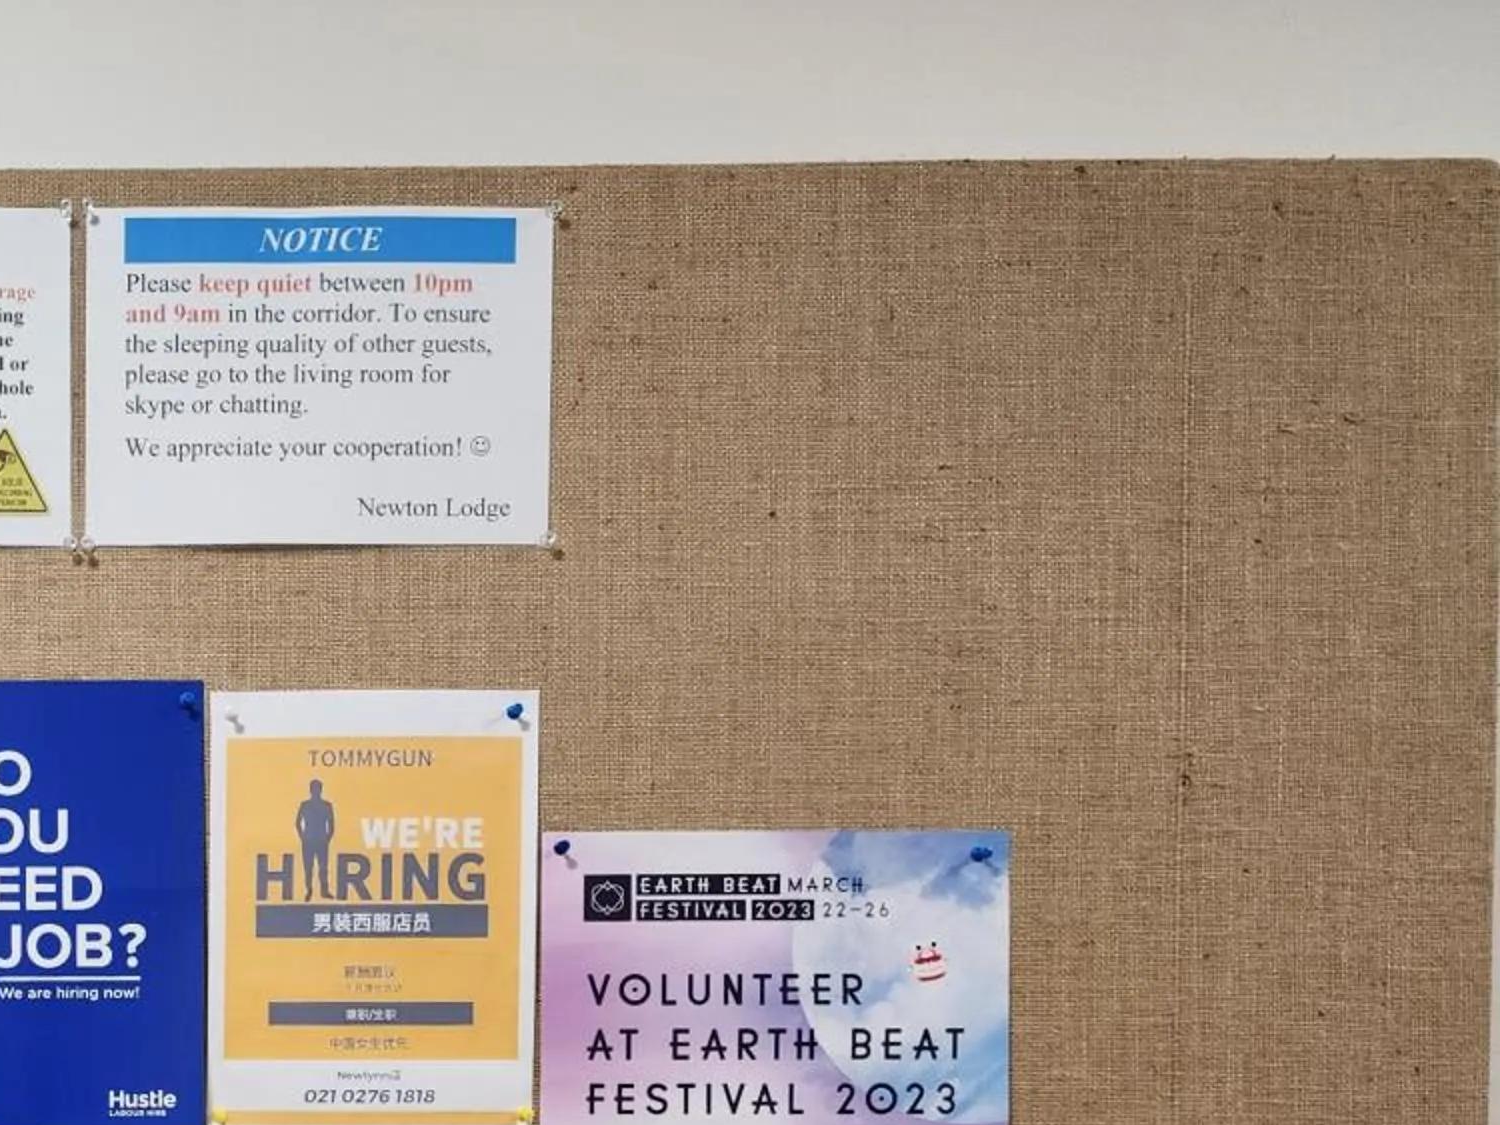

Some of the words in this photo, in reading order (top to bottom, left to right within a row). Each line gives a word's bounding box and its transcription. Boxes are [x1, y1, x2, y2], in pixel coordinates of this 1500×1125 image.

[260, 226, 383, 253] NOTICE
[126, 273, 192, 293] Please
[199, 274, 249, 297] keep
[257, 275, 311, 297] quiet
[319, 273, 405, 293] between
[413, 273, 472, 296] 10pm
[358, 498, 438, 517] Newton
[446, 497, 510, 520] Lodge
[308, 751, 433, 767] TOMMYGUN
[361, 817, 485, 850] WE'RE
[639, 877, 710, 894] EARTH
[723, 877, 778, 893] BEAT
[787, 877, 864, 893] MARCH
[639, 903, 743, 919] FESTIVAL
[754, 903, 813, 918] 2023
[313, 913, 431, 933] 男装西服店员
[0, 987, 24, 1000] We
[27, 989, 51, 1000] are
[56, 986, 99, 1001] hiring
[104, 986, 140, 1000] now!
[587, 974, 863, 1005] VOLUNTEER
[587, 1029, 639, 1060] AT
[669, 1029, 818, 1060] EARTH
[851, 1028, 965, 1060] BEAT
[109, 1090, 176, 1109] Hustle
[305, 1089, 335, 1104] 021
[341, 1089, 390, 1104] 0276
[395, 1089, 435, 1104] 1818
[586, 1083, 804, 1115] FESTIVAL
[836, 1083, 956, 1115] 2023
